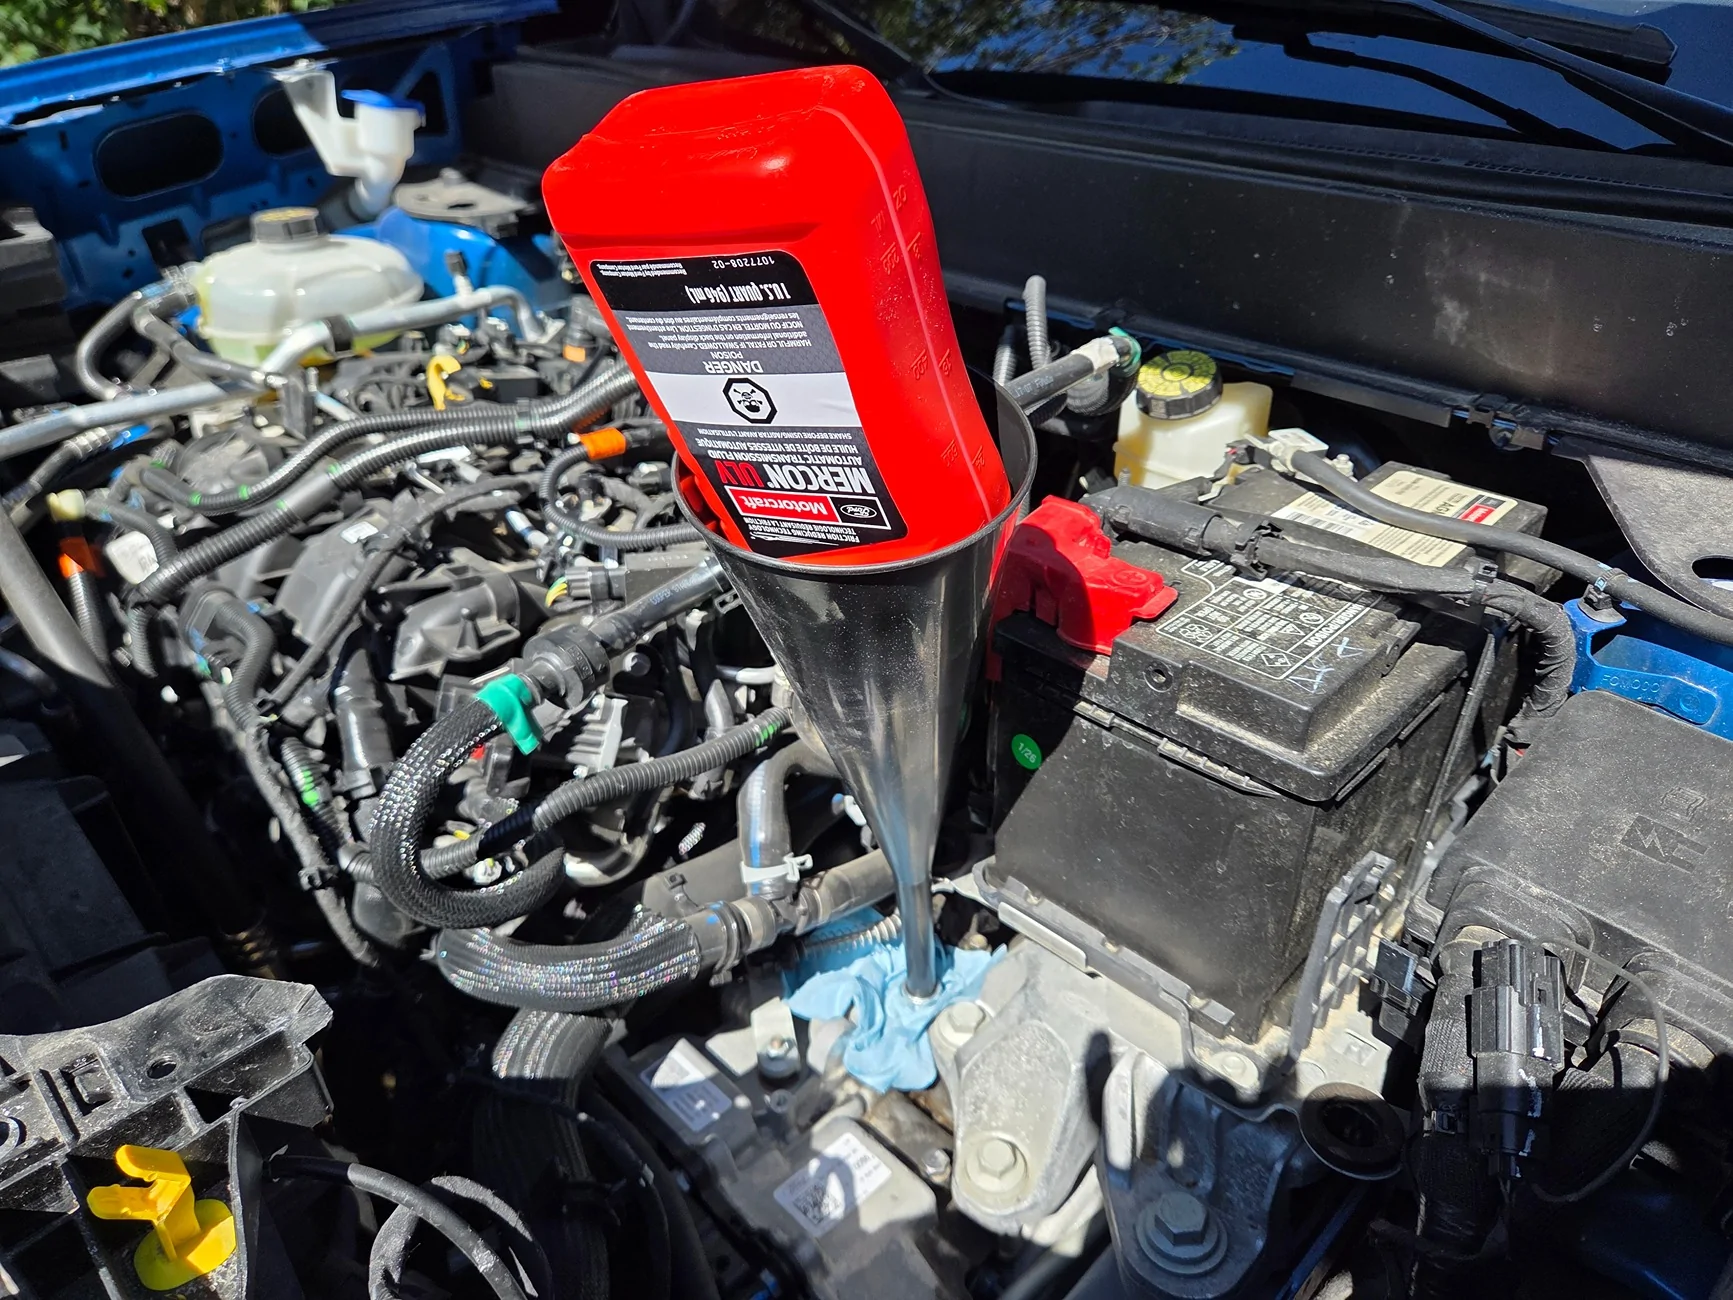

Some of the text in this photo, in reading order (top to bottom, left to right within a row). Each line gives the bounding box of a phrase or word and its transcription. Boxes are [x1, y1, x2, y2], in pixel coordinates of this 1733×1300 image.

[711, 255, 774, 268] 1077208-02
[726, 281, 762, 302] QUART
[758, 282, 782, 300] U.S.
[779, 282, 790, 298] 1
[787, 311, 799, 319] les
[717, 323, 731, 331] CAS
[741, 321, 769, 329] MORTEL
[769, 321, 781, 329] OU
[780, 320, 803, 328] NOCIF
[771, 330, 807, 339] additional
[744, 340, 766, 348] FATAL
[765, 339, 777, 347] OR
[776, 338, 811, 347] HARMFUL
[709, 350, 743, 359] POISON
[701, 359, 763, 373] DANGER
[694, 437, 858, 454] HUILE DE BOÎTE DE VITESSES AUTOMATIQUE
[706, 449, 861, 465] AUTOMATIC TRANSMISSION FLUID
[714, 459, 763, 487] ULV
[737, 495, 827, 514] Motorcraft
[844, 504, 870, 517] Ford
[742, 516, 772, 525] FRICTION
[747, 523, 859, 542] FRICTION REDUCING TECHNOLOGY
[812, 524, 855, 534] TECHNOLOGIE
[1018, 742, 1037, 763] 1/26
